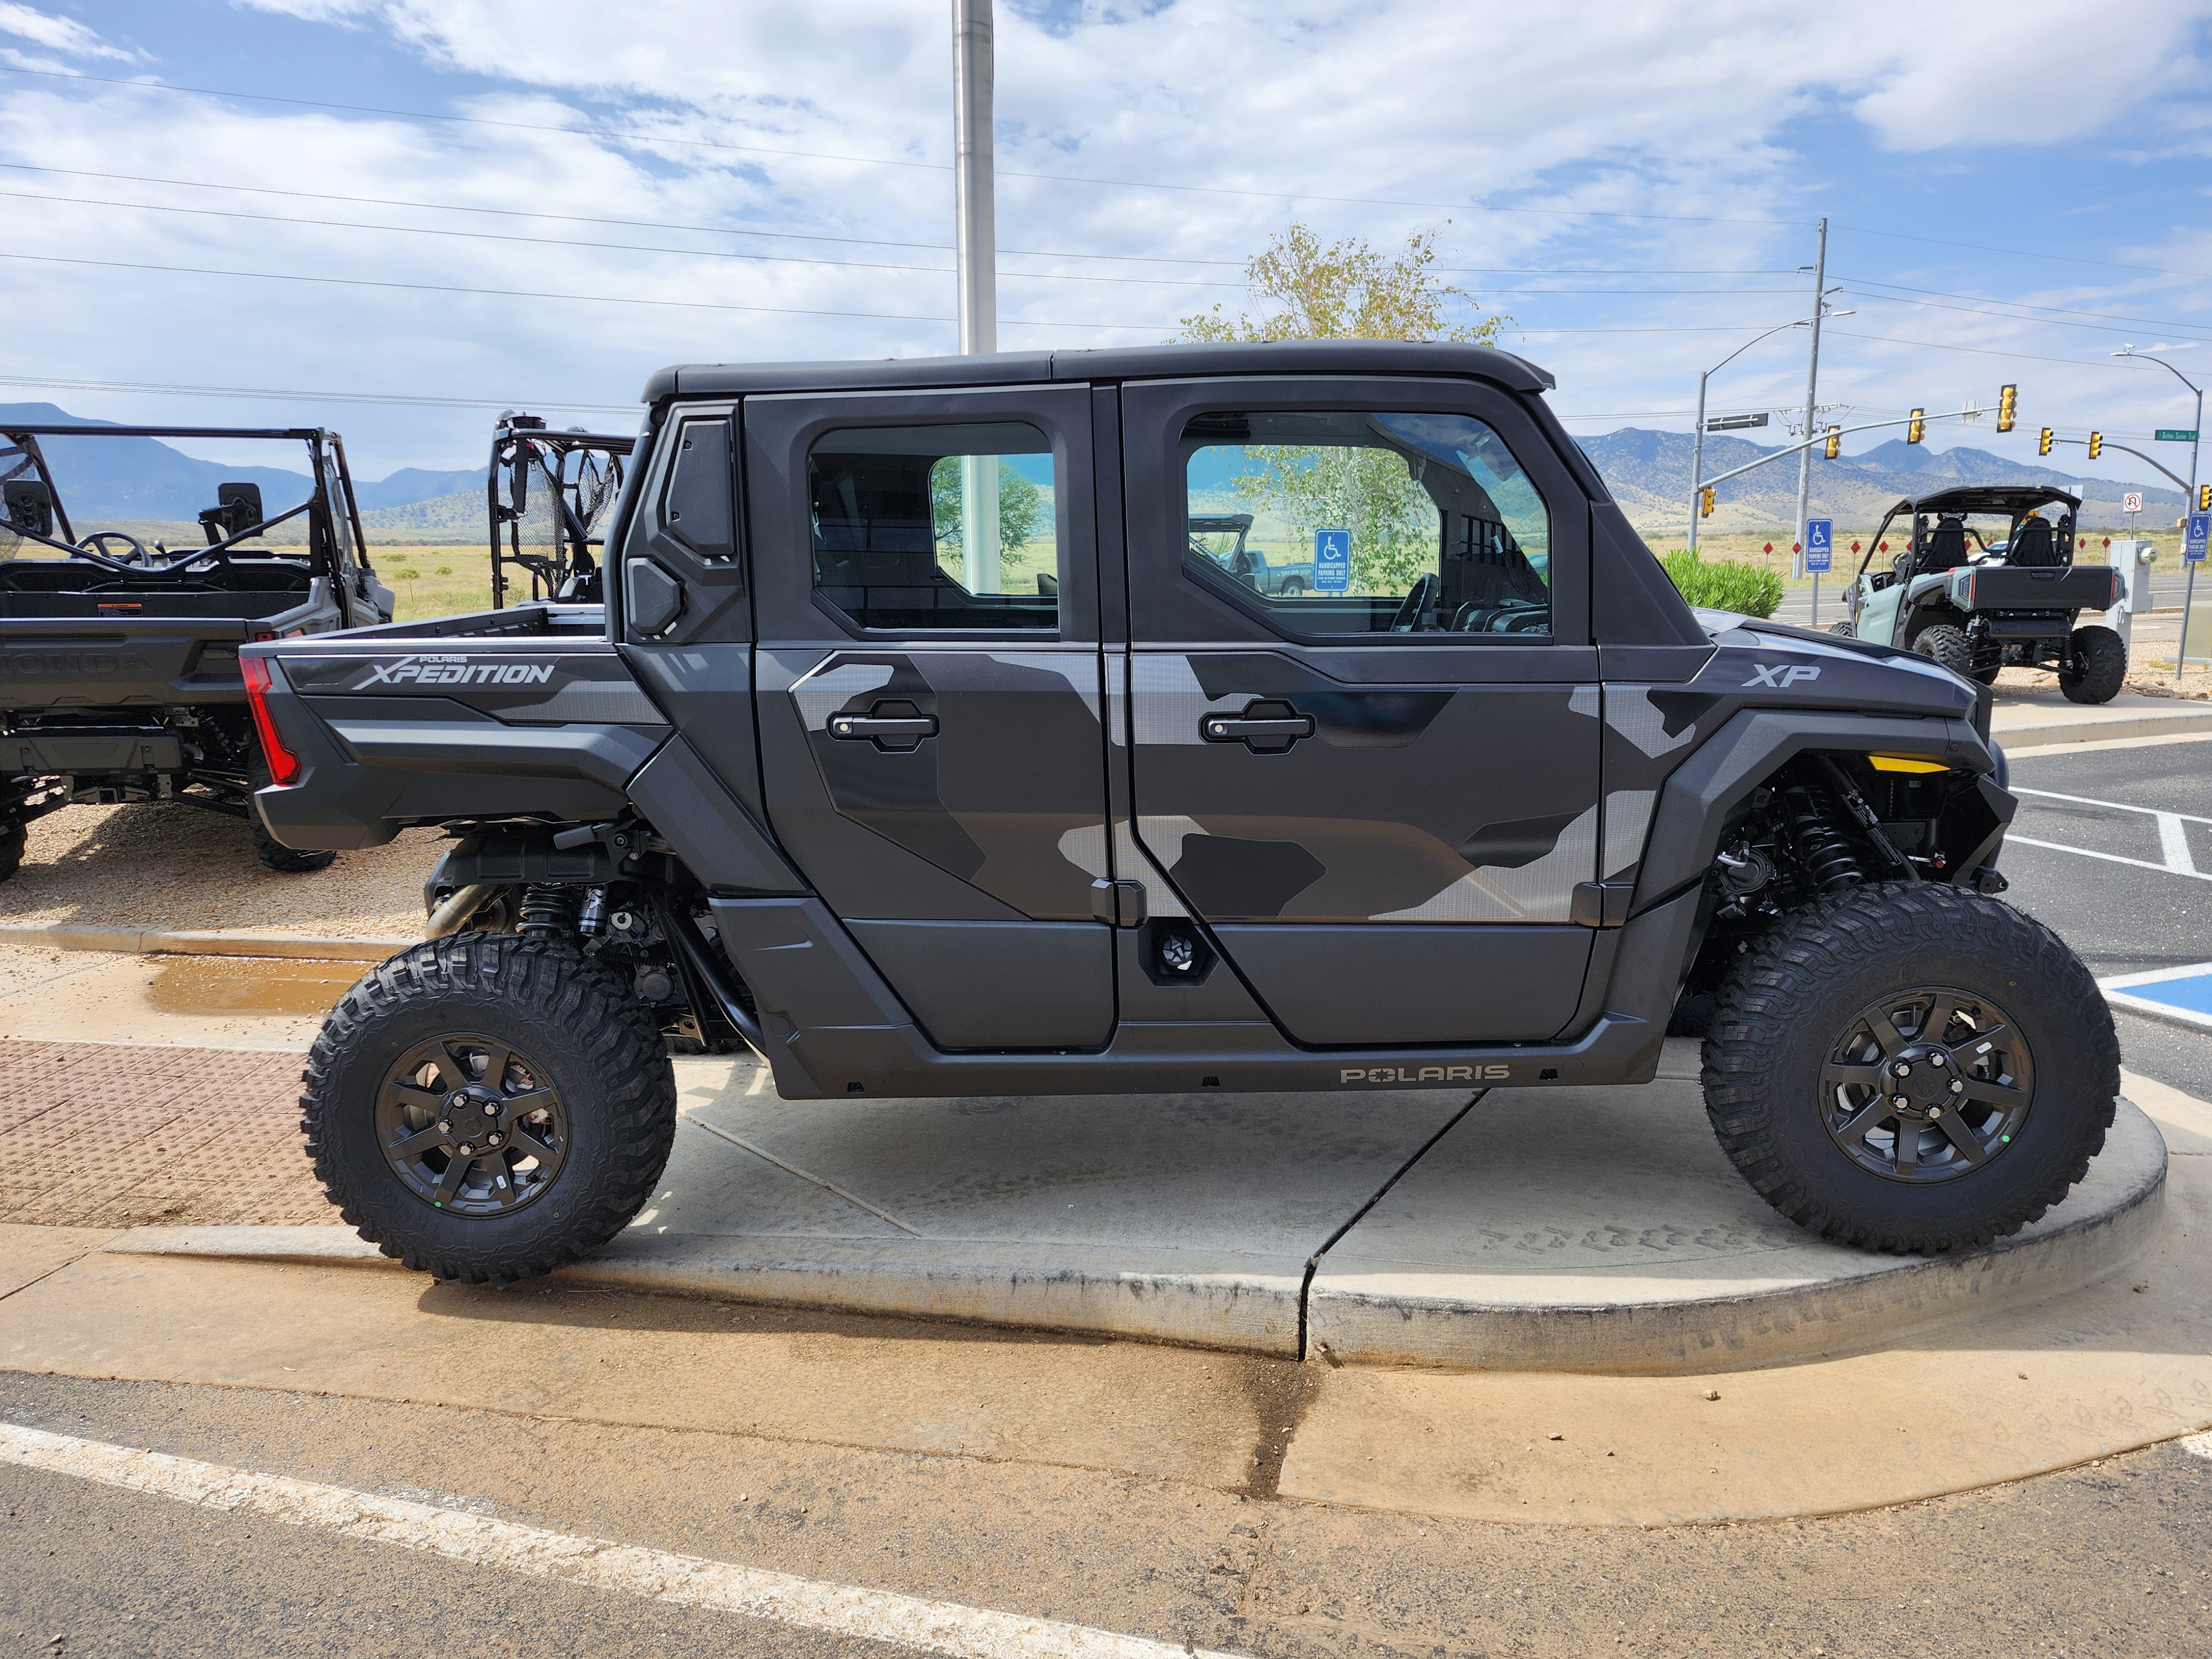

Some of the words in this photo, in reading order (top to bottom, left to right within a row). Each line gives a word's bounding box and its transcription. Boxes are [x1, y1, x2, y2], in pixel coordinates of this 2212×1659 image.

[352, 656, 555, 690] XPEDITION
[1740, 664, 1822, 688] XP
[1340, 1065, 1510, 1083] POLARIS
